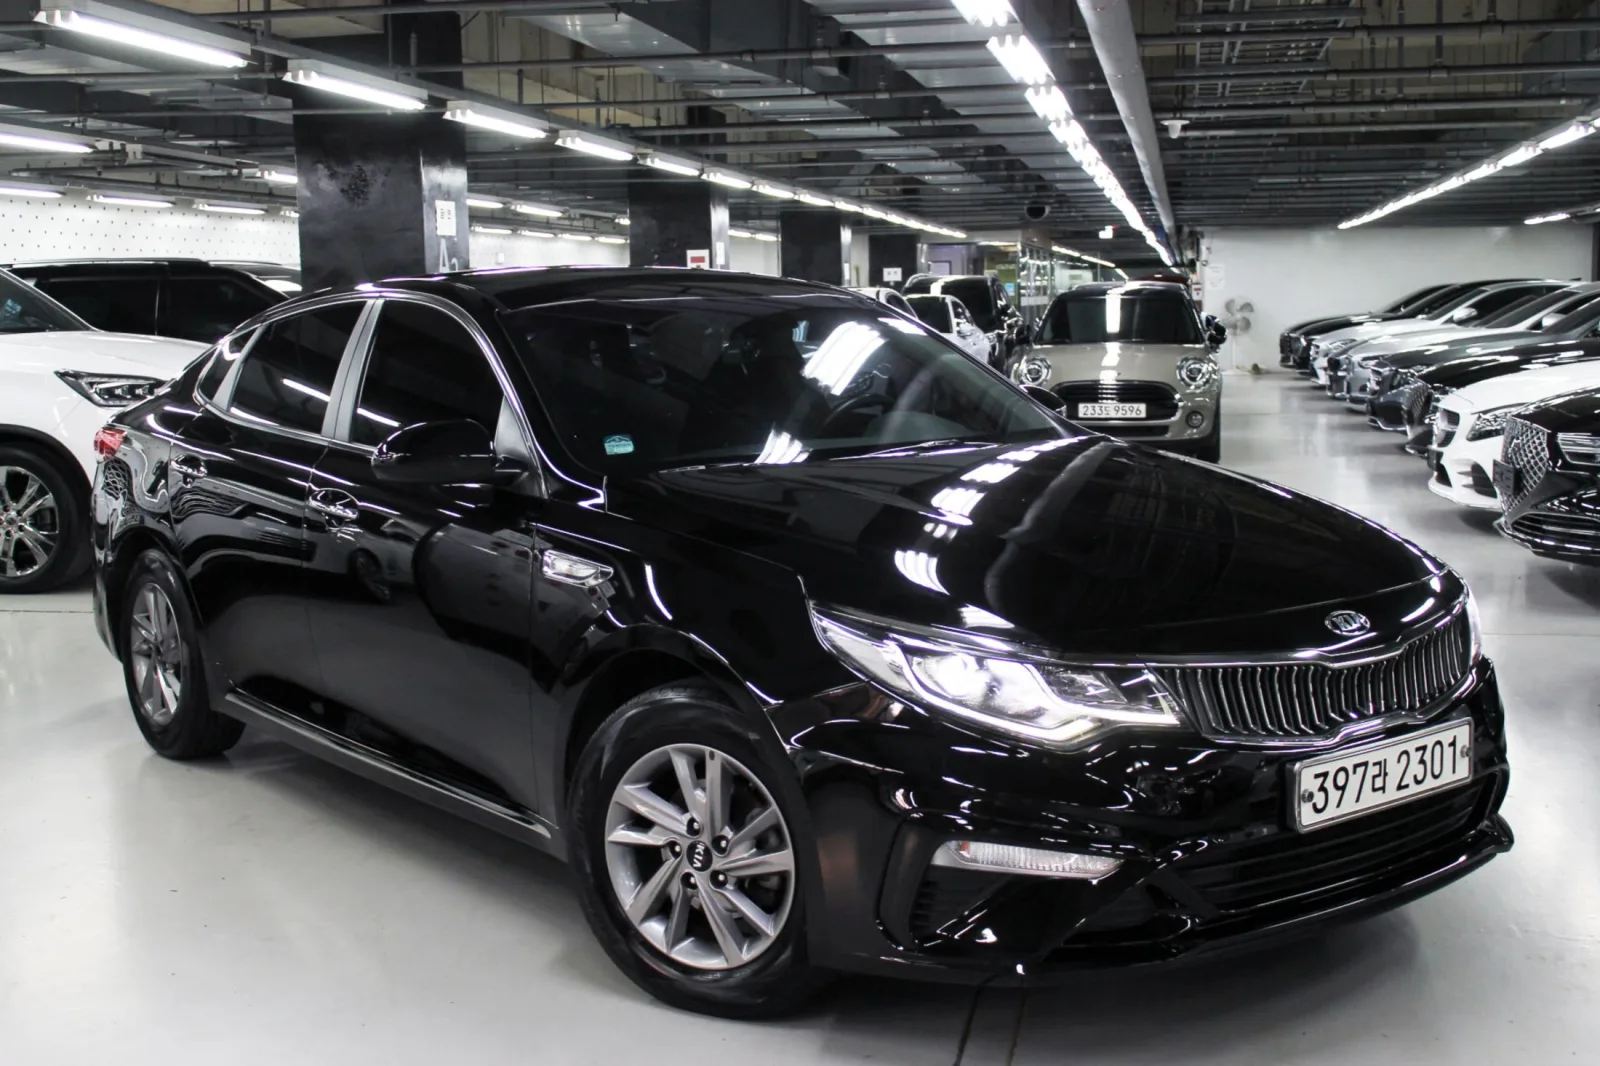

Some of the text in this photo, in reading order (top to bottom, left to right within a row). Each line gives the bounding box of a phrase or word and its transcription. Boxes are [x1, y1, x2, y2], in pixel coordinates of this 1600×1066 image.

[1113, 405, 1142, 416] 9596
[1331, 613, 1364, 632] KIA
[1312, 735, 1457, 814] 397라 2301
[692, 843, 705, 868] KIA
